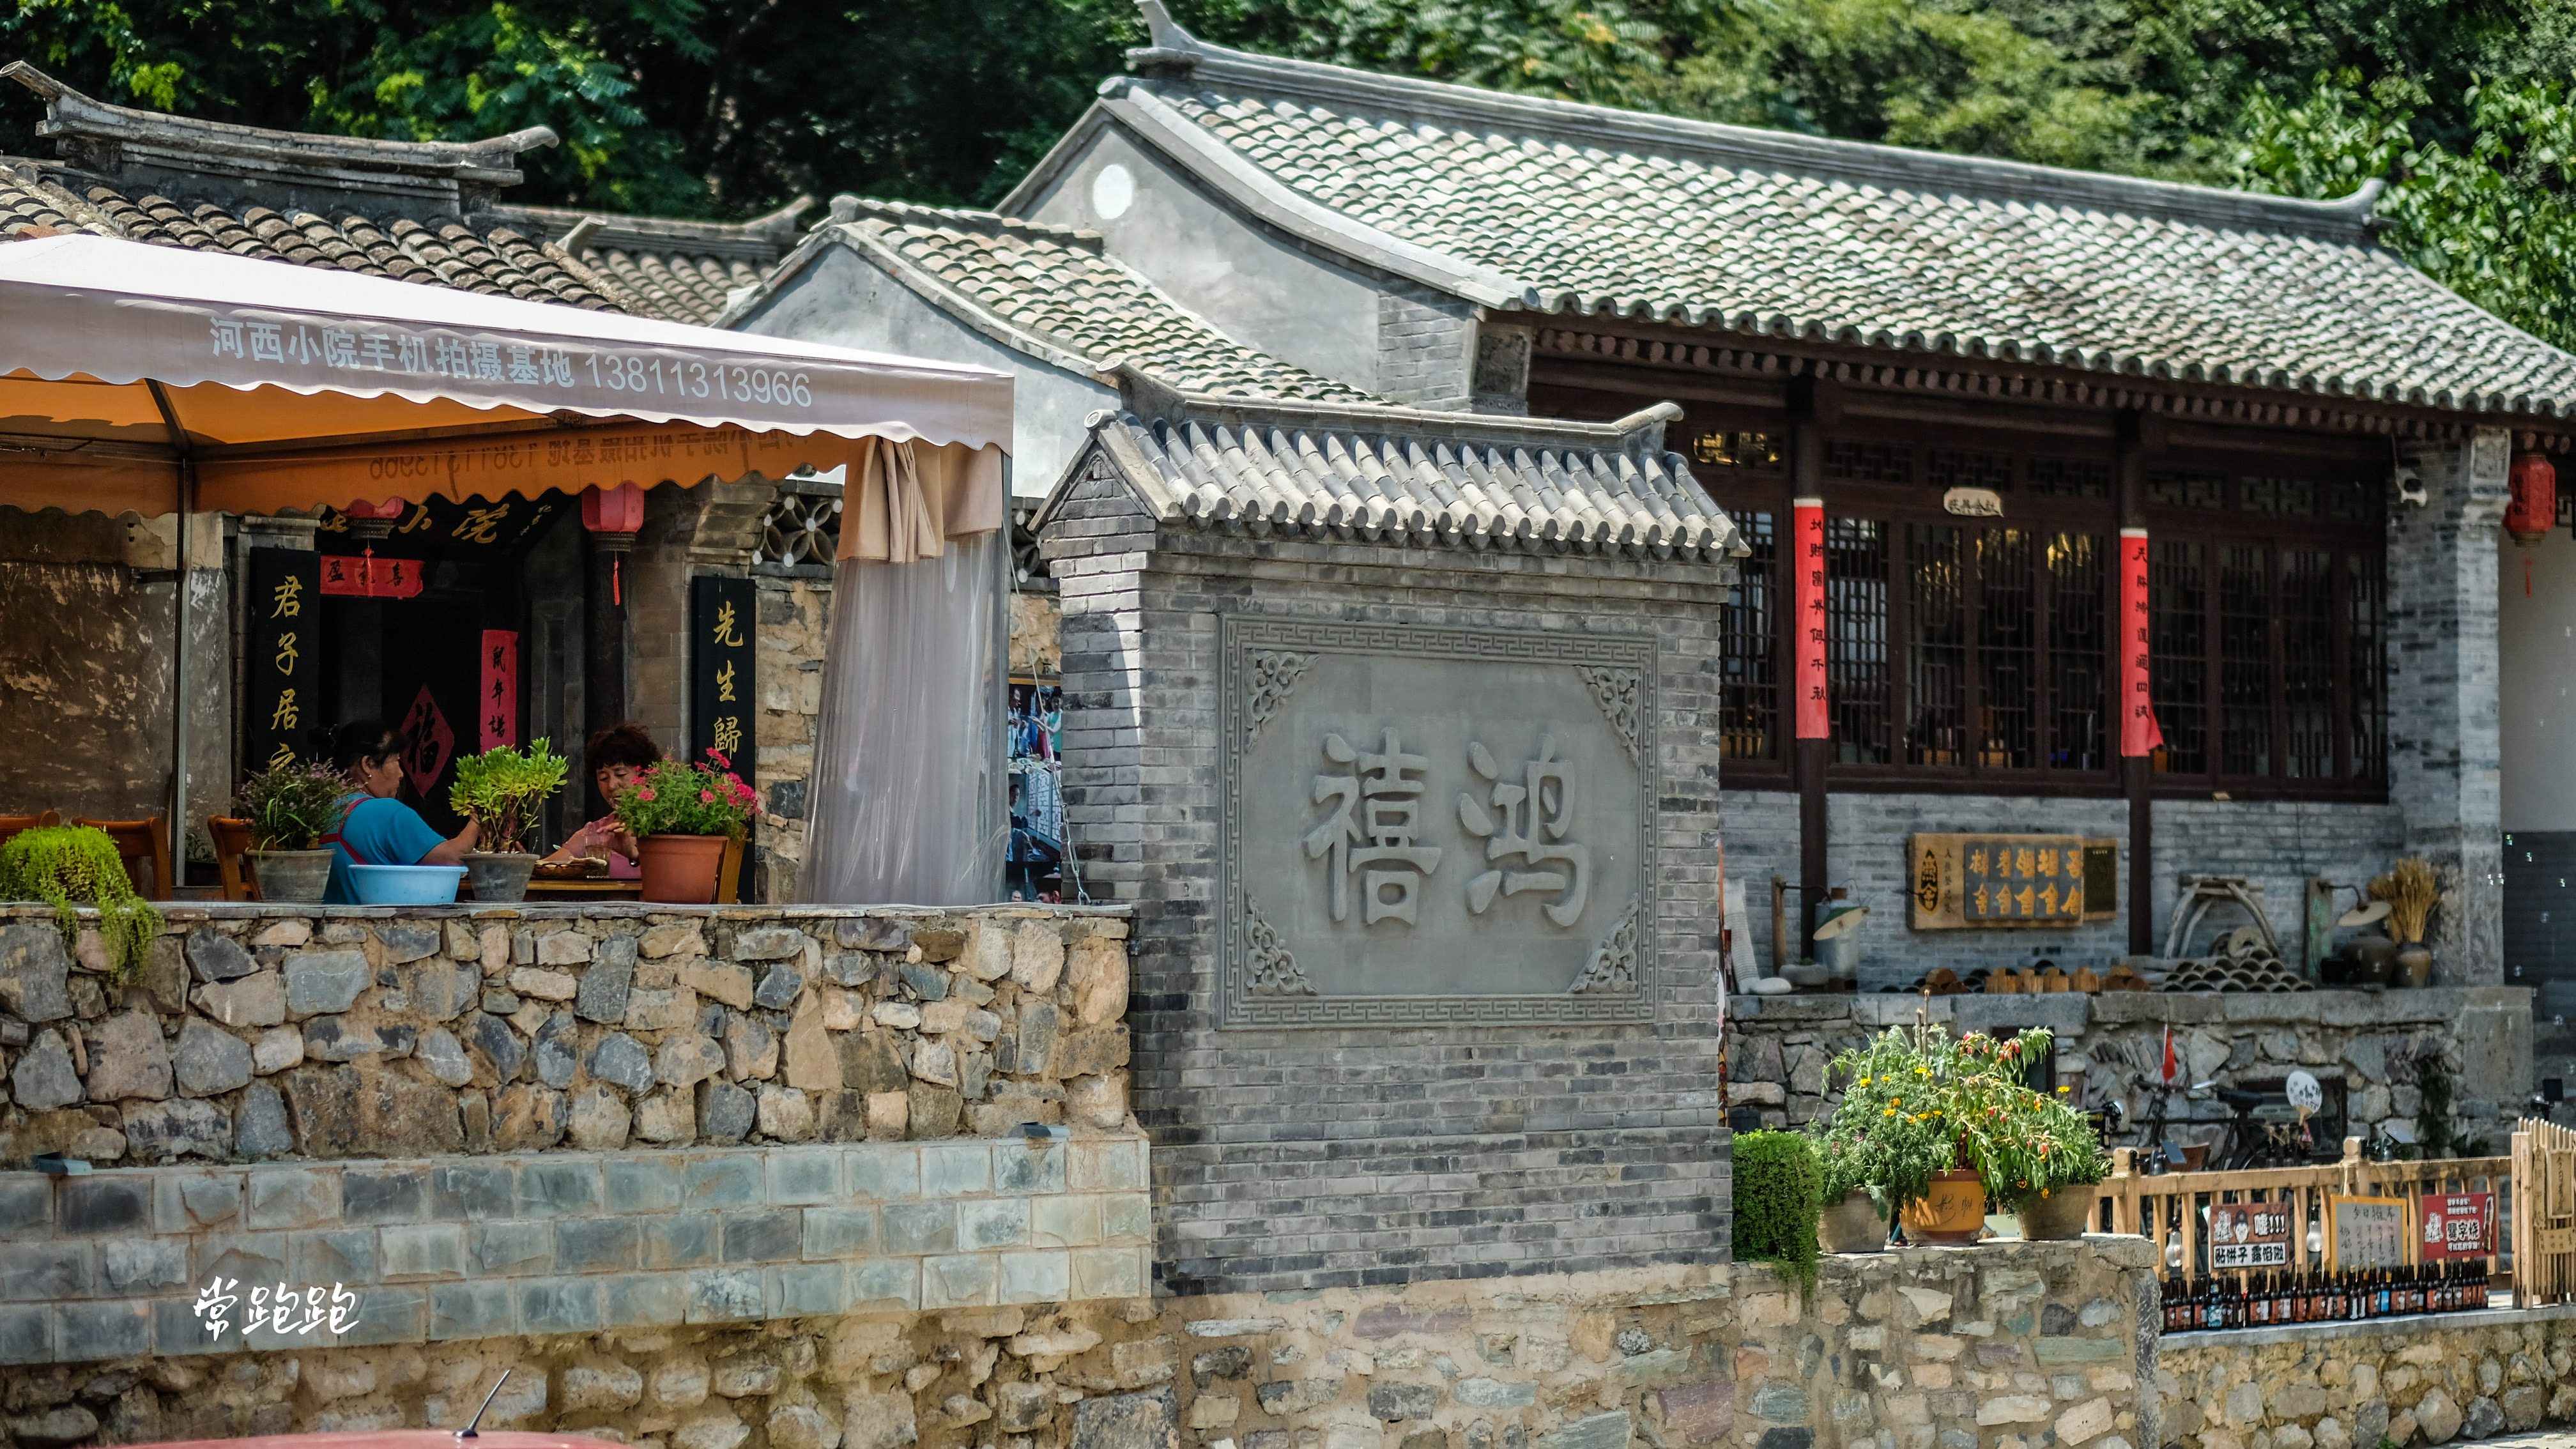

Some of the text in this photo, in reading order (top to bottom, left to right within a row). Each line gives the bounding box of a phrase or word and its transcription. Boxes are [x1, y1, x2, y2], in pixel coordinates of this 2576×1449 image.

[210, 317, 812, 407] 河西小院手机拍摄基地 13811313966
[407, 702, 440, 774] 福
